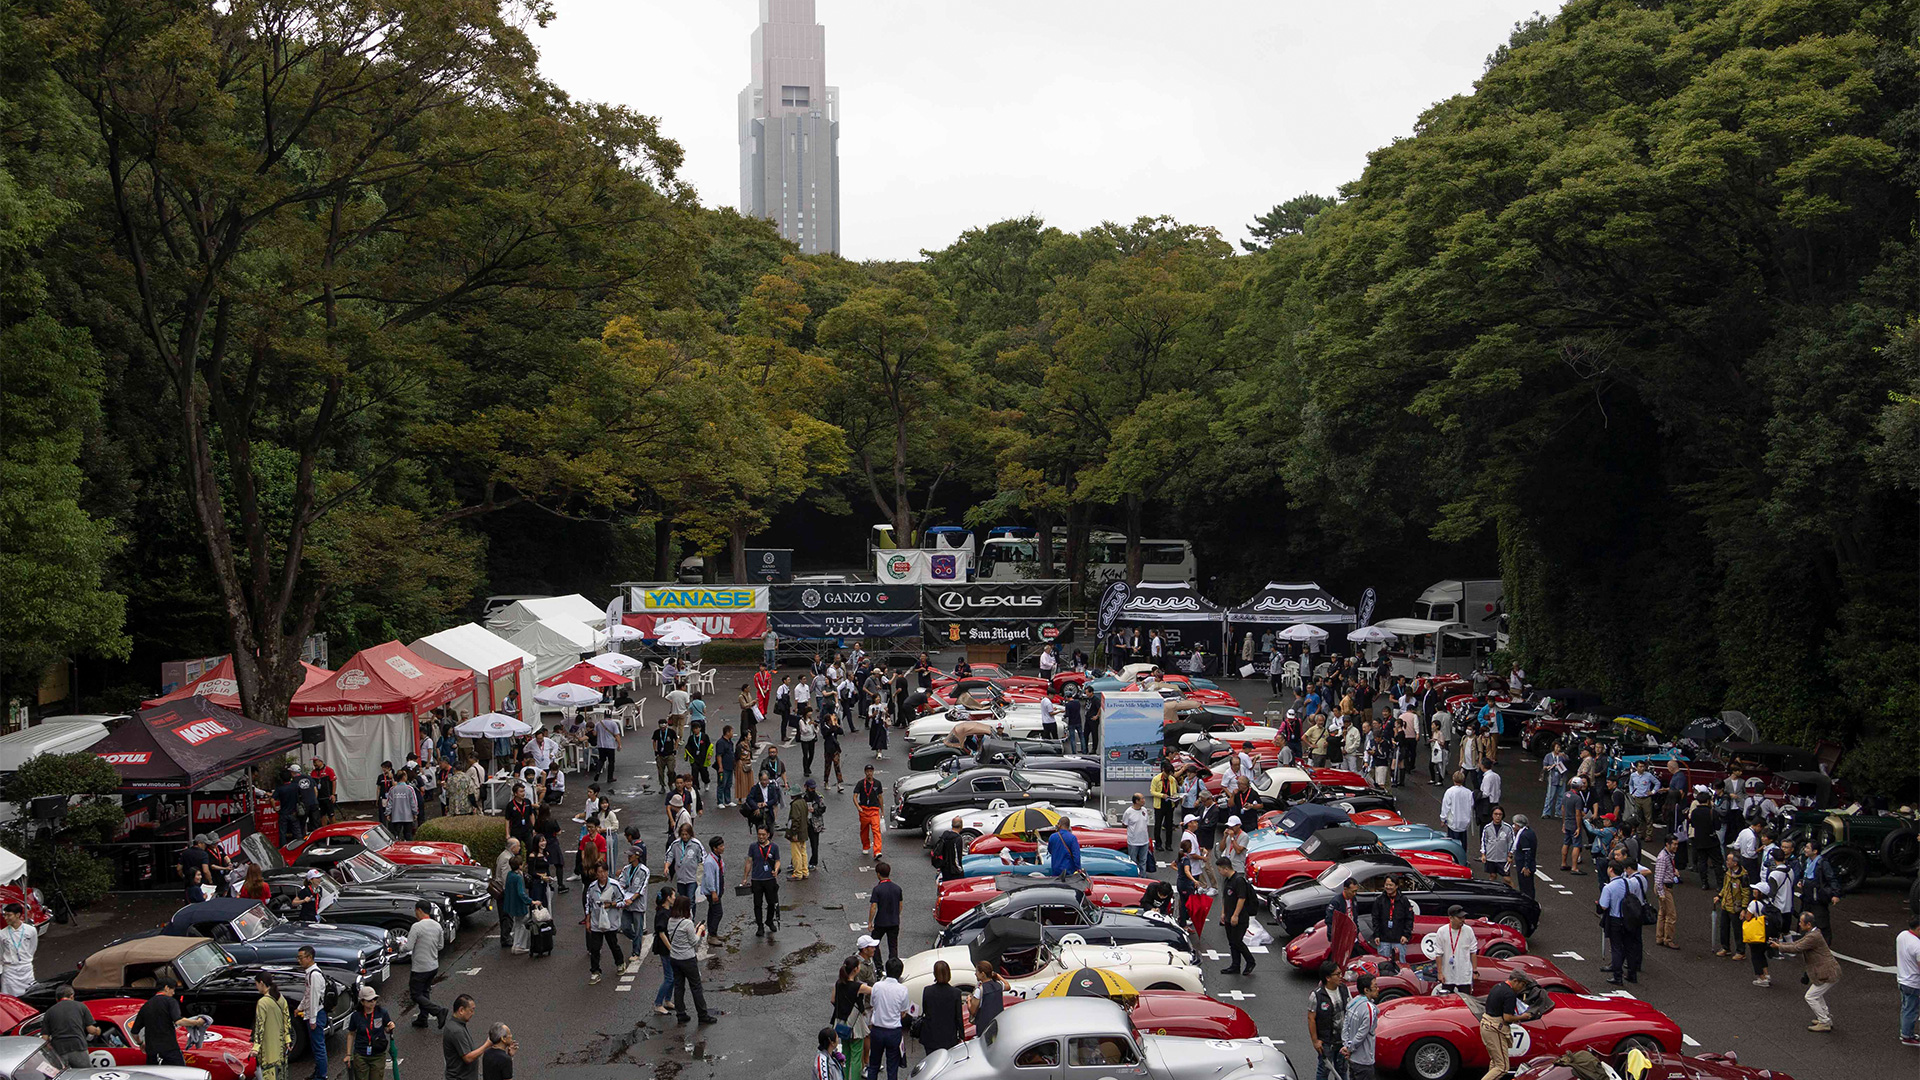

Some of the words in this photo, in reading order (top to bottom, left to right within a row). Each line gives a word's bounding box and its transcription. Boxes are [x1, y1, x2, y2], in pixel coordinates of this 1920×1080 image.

[649, 591, 751, 606] YANASE
[824, 592, 871, 604] GANZO
[967, 595, 1043, 607] LEXUS
[825, 616, 864, 624] muta
[969, 628, 991, 640] San
[991, 627, 1031, 640] Miguel
[202, 680, 231, 688] 1000
[316, 704, 336, 712] Festa
[337, 704, 357, 712] Mille
[358, 703, 382, 712] Miglia
[179, 720, 229, 744] MOTUL
[1425, 939, 1434, 952] 3
[1513, 1031, 1524, 1049] 7
